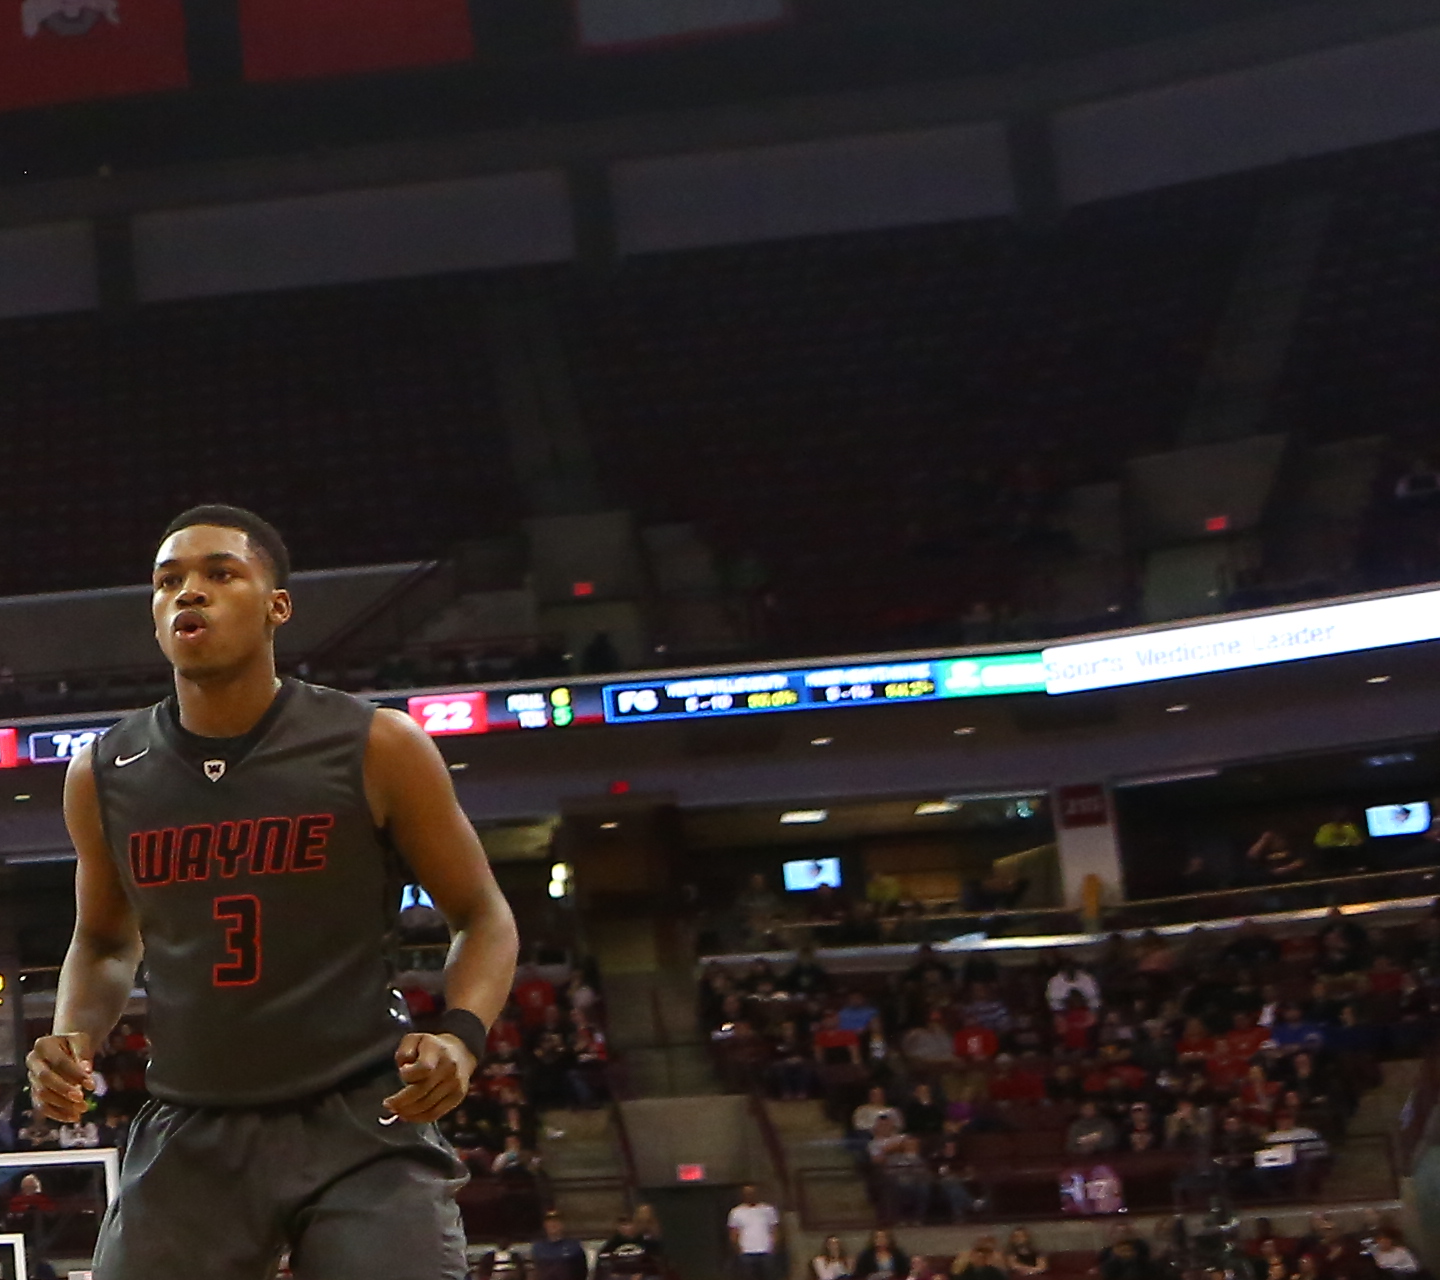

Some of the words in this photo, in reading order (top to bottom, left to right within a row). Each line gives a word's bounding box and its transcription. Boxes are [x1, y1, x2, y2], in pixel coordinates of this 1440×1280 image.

[422, 700, 473, 731] 22
[129, 813, 335, 888] WAYNE
[213, 893, 260, 987] 3
